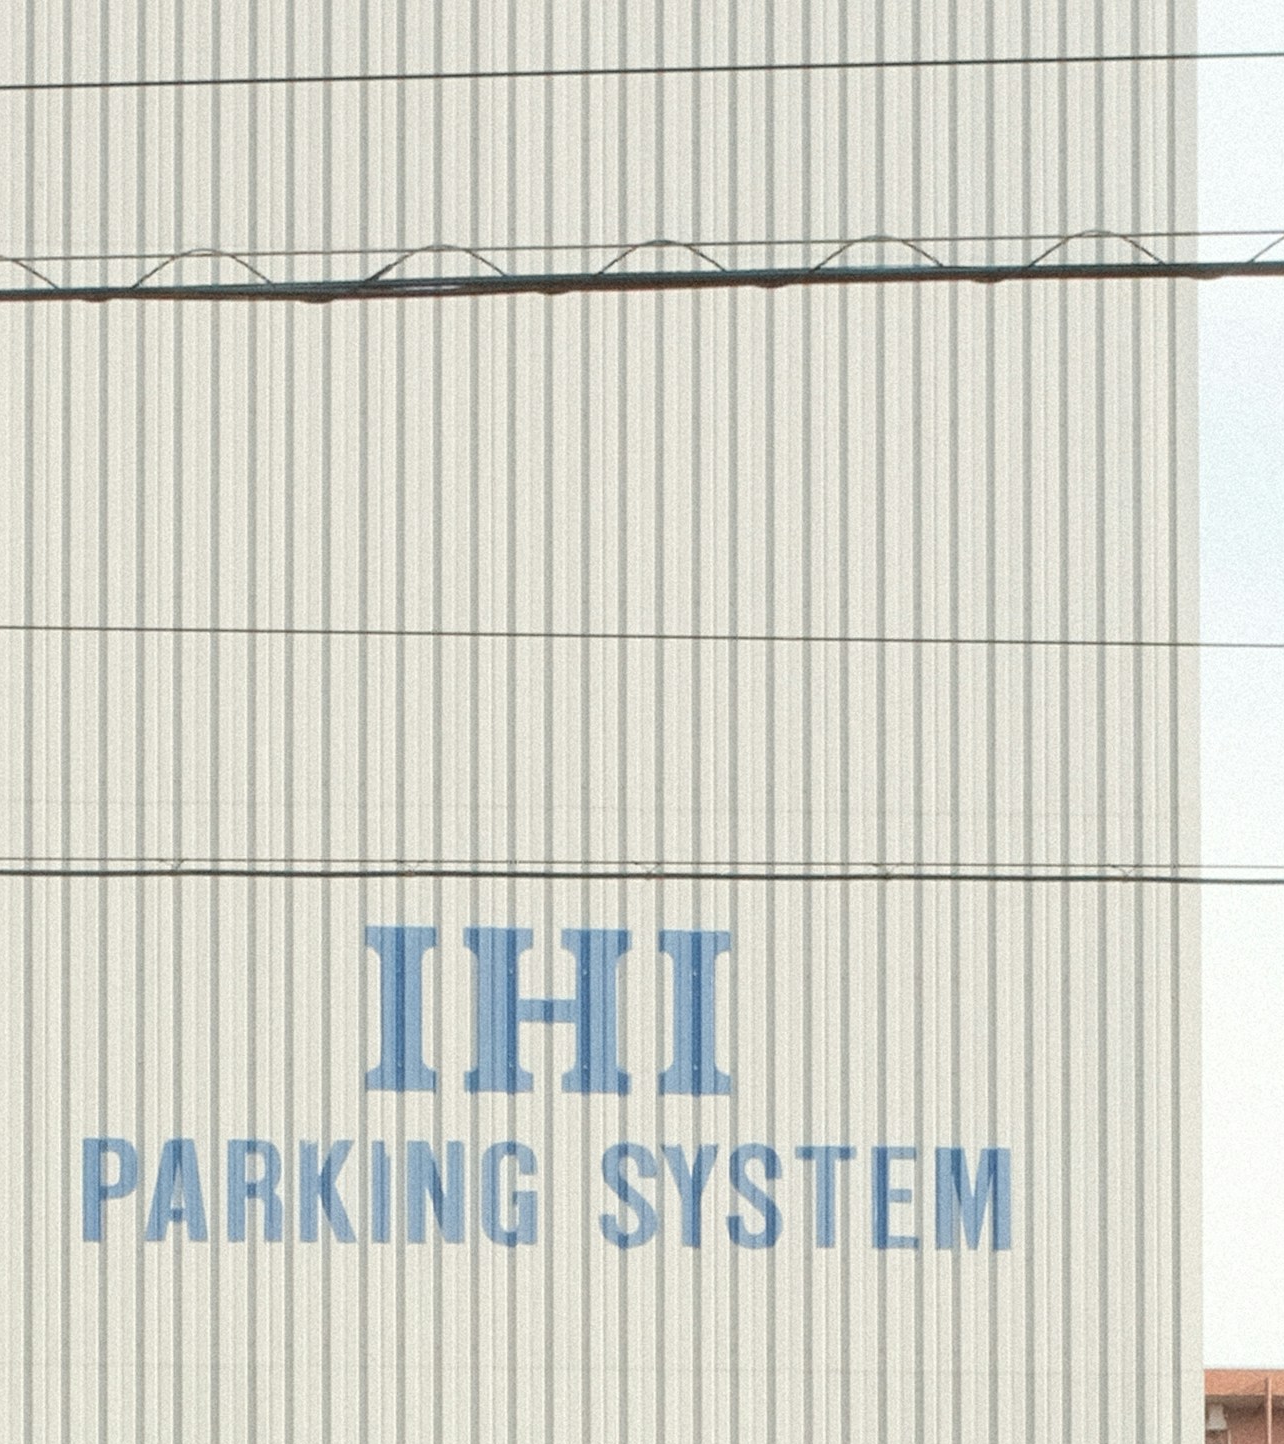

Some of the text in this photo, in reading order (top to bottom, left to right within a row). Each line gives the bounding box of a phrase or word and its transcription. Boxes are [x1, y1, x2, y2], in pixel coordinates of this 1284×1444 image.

[364, 925, 731, 1097] IHI
[82, 1138, 1012, 1252] PARKING SYSTEM
